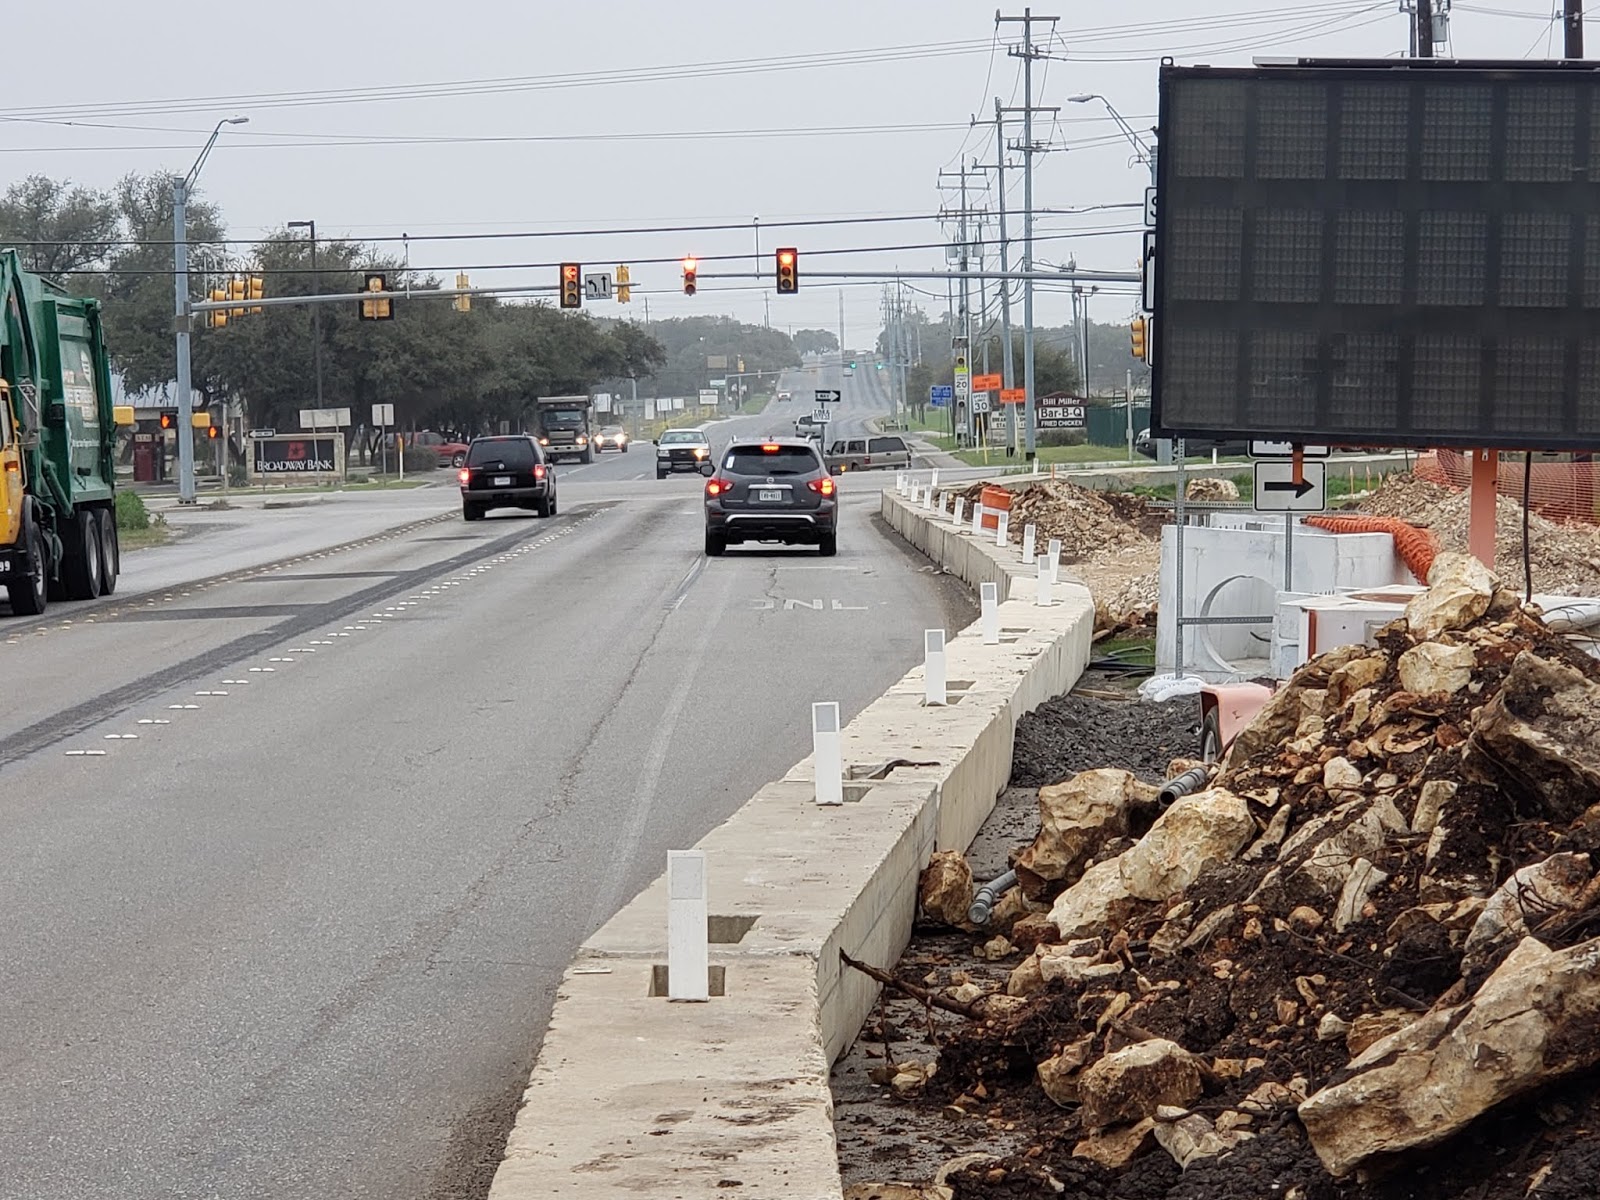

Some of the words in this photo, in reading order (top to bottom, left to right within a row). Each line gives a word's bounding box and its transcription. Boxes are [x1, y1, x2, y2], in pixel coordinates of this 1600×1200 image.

[1057, 397, 1081, 405] Miller
[974, 402, 988, 411] 30
[257, 460, 307, 471] BROADWAY
[307, 459, 333, 470] BANK
[750, 599, 870, 610] ONL
